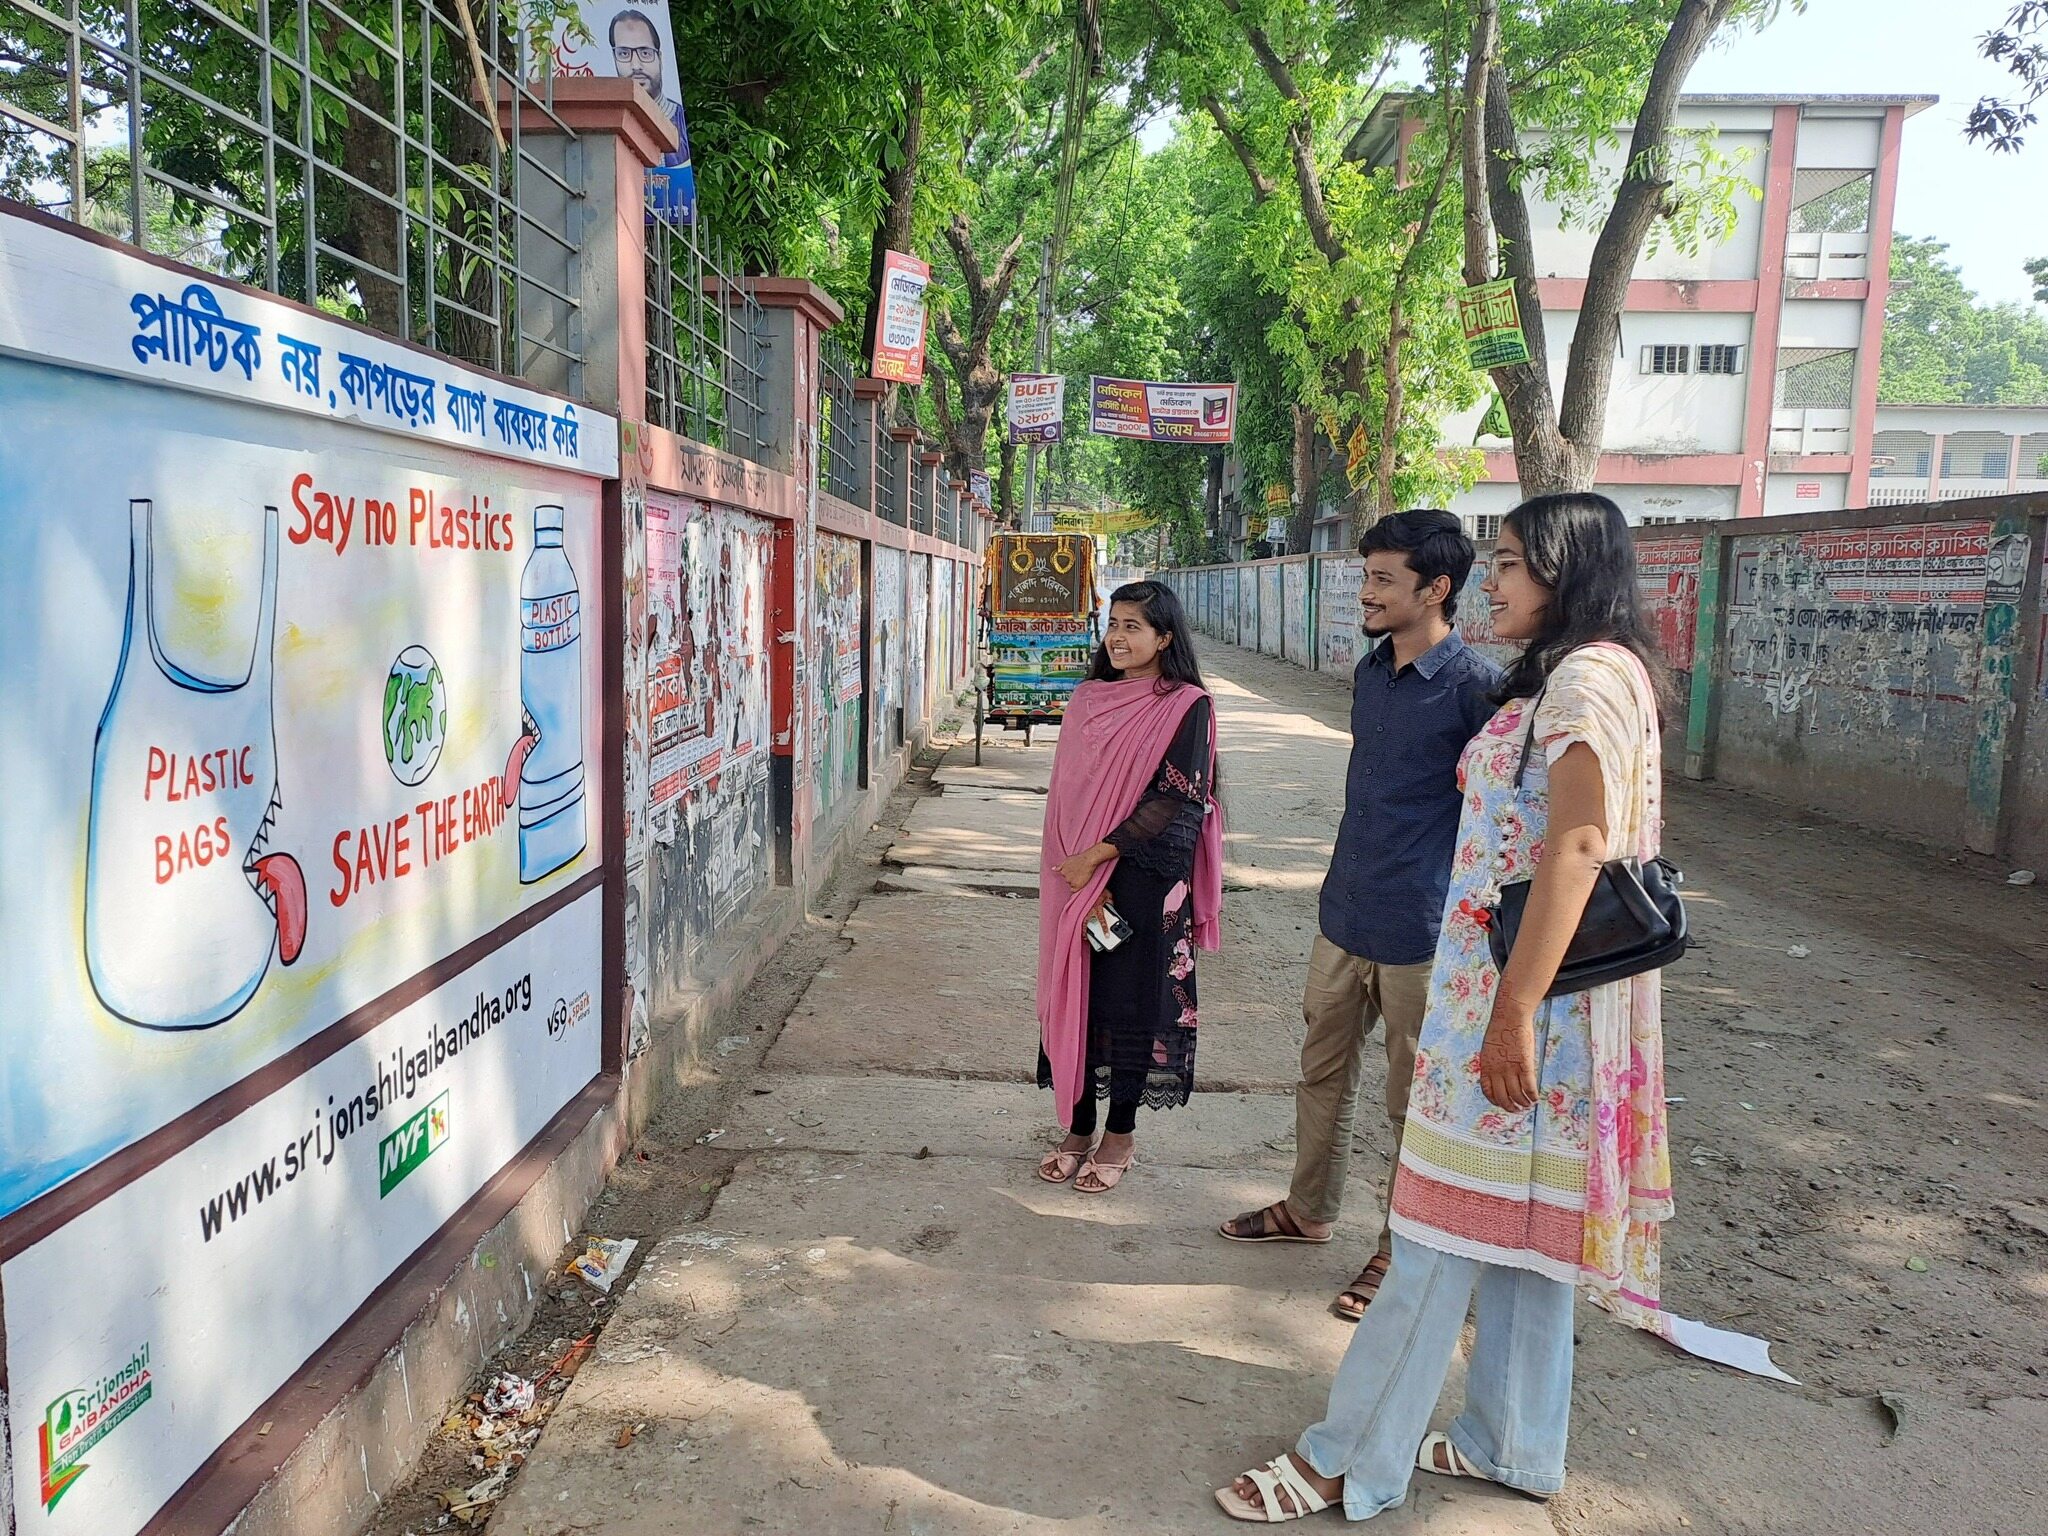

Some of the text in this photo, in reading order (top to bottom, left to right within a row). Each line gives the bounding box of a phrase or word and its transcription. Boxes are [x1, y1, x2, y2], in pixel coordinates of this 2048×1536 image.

[130, 284, 261, 381] প্লাস্টিক
[338, 352, 435, 428] কাপড়ের
[445, 384, 487, 436] ব্যাগ
[493, 398, 548, 451] ব্যবহার
[551, 404, 579, 458] করি
[1015, 382, 1058, 397] BUET
[1097, 384, 1143, 399] মেডিকেল
[1121, 403, 1143, 413] Math
[1153, 418, 1194, 437] উন্মেষ
[288, 473, 355, 556] Say
[365, 499, 397, 545] no
[532, 596, 572, 625] PLASTIC
[1872, 591, 1889, 599] UCC
[1930, 590, 1949, 599] UCC
[535, 620, 571, 650] BOTTLE
[145, 746, 254, 801] PLASTIC
[155, 817, 230, 885] BAGS
[330, 776, 504, 907] SAVE THE EARTH
[200, 971, 532, 1243] www.srijonshilgaibandha.org
[381, 1108, 429, 1181] NYF
[77, 1341, 151, 1418] Srijonshil
[59, 1369, 152, 1450] GAIBANDHA
